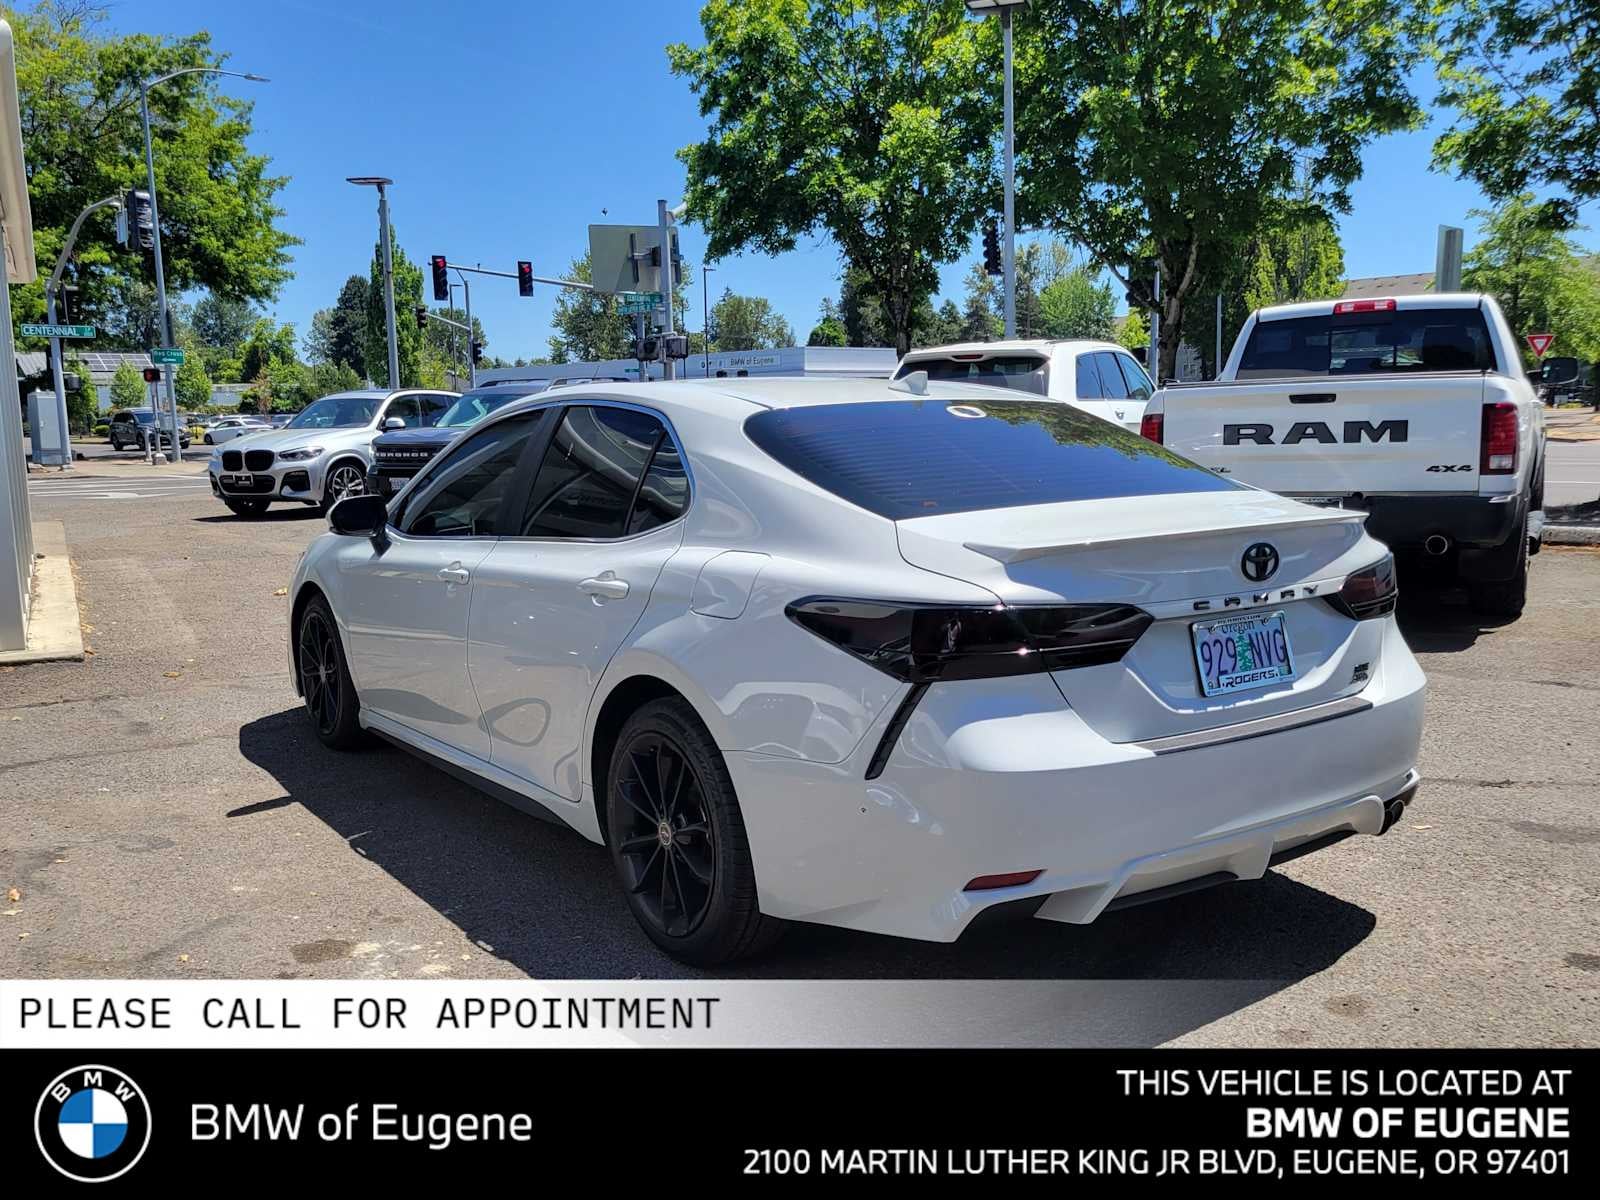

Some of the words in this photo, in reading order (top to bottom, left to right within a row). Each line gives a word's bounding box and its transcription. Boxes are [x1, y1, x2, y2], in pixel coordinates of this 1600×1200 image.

[23, 325, 80, 336] CENTENNIAL
[730, 357, 745, 366] BMW
[1223, 419, 1409, 446] RAM
[1222, 620, 1255, 635] Oregon
[1200, 636, 1238, 678] 929
[1248, 628, 1287, 670] NVG
